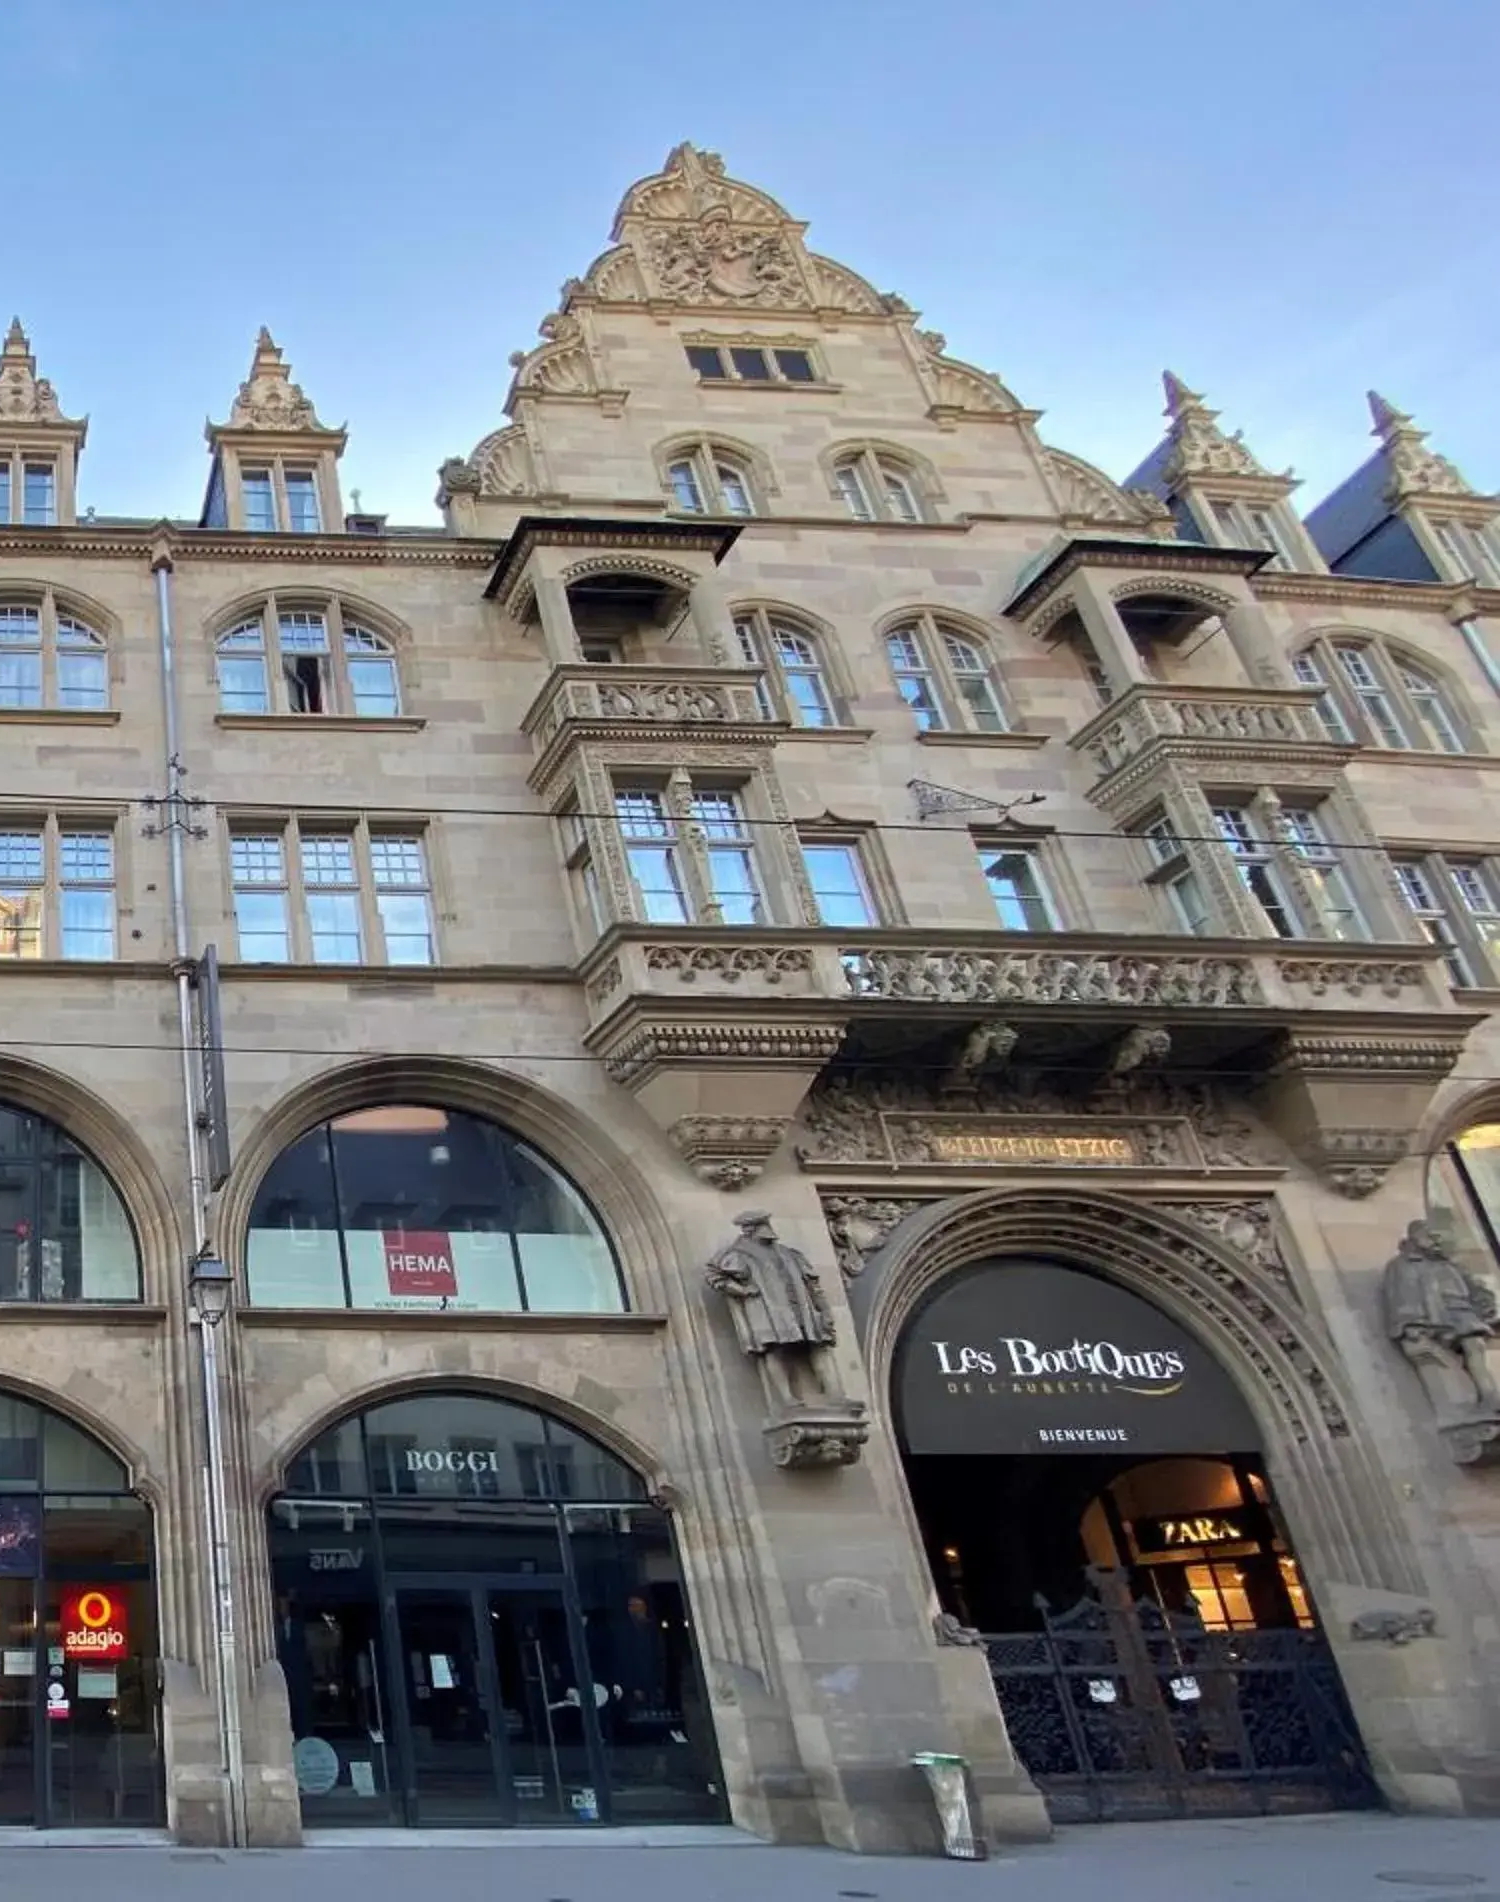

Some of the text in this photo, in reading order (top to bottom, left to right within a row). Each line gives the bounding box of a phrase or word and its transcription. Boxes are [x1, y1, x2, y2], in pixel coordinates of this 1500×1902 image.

[389, 1254, 451, 1273] HEMA
[946, 1381, 972, 1394] DE
[1039, 1428, 1129, 1442] BIENVENUE
[405, 1450, 501, 1473] BOGGI
[1158, 1518, 1240, 1545] ZARA
[66, 1626, 124, 1648] adagio
